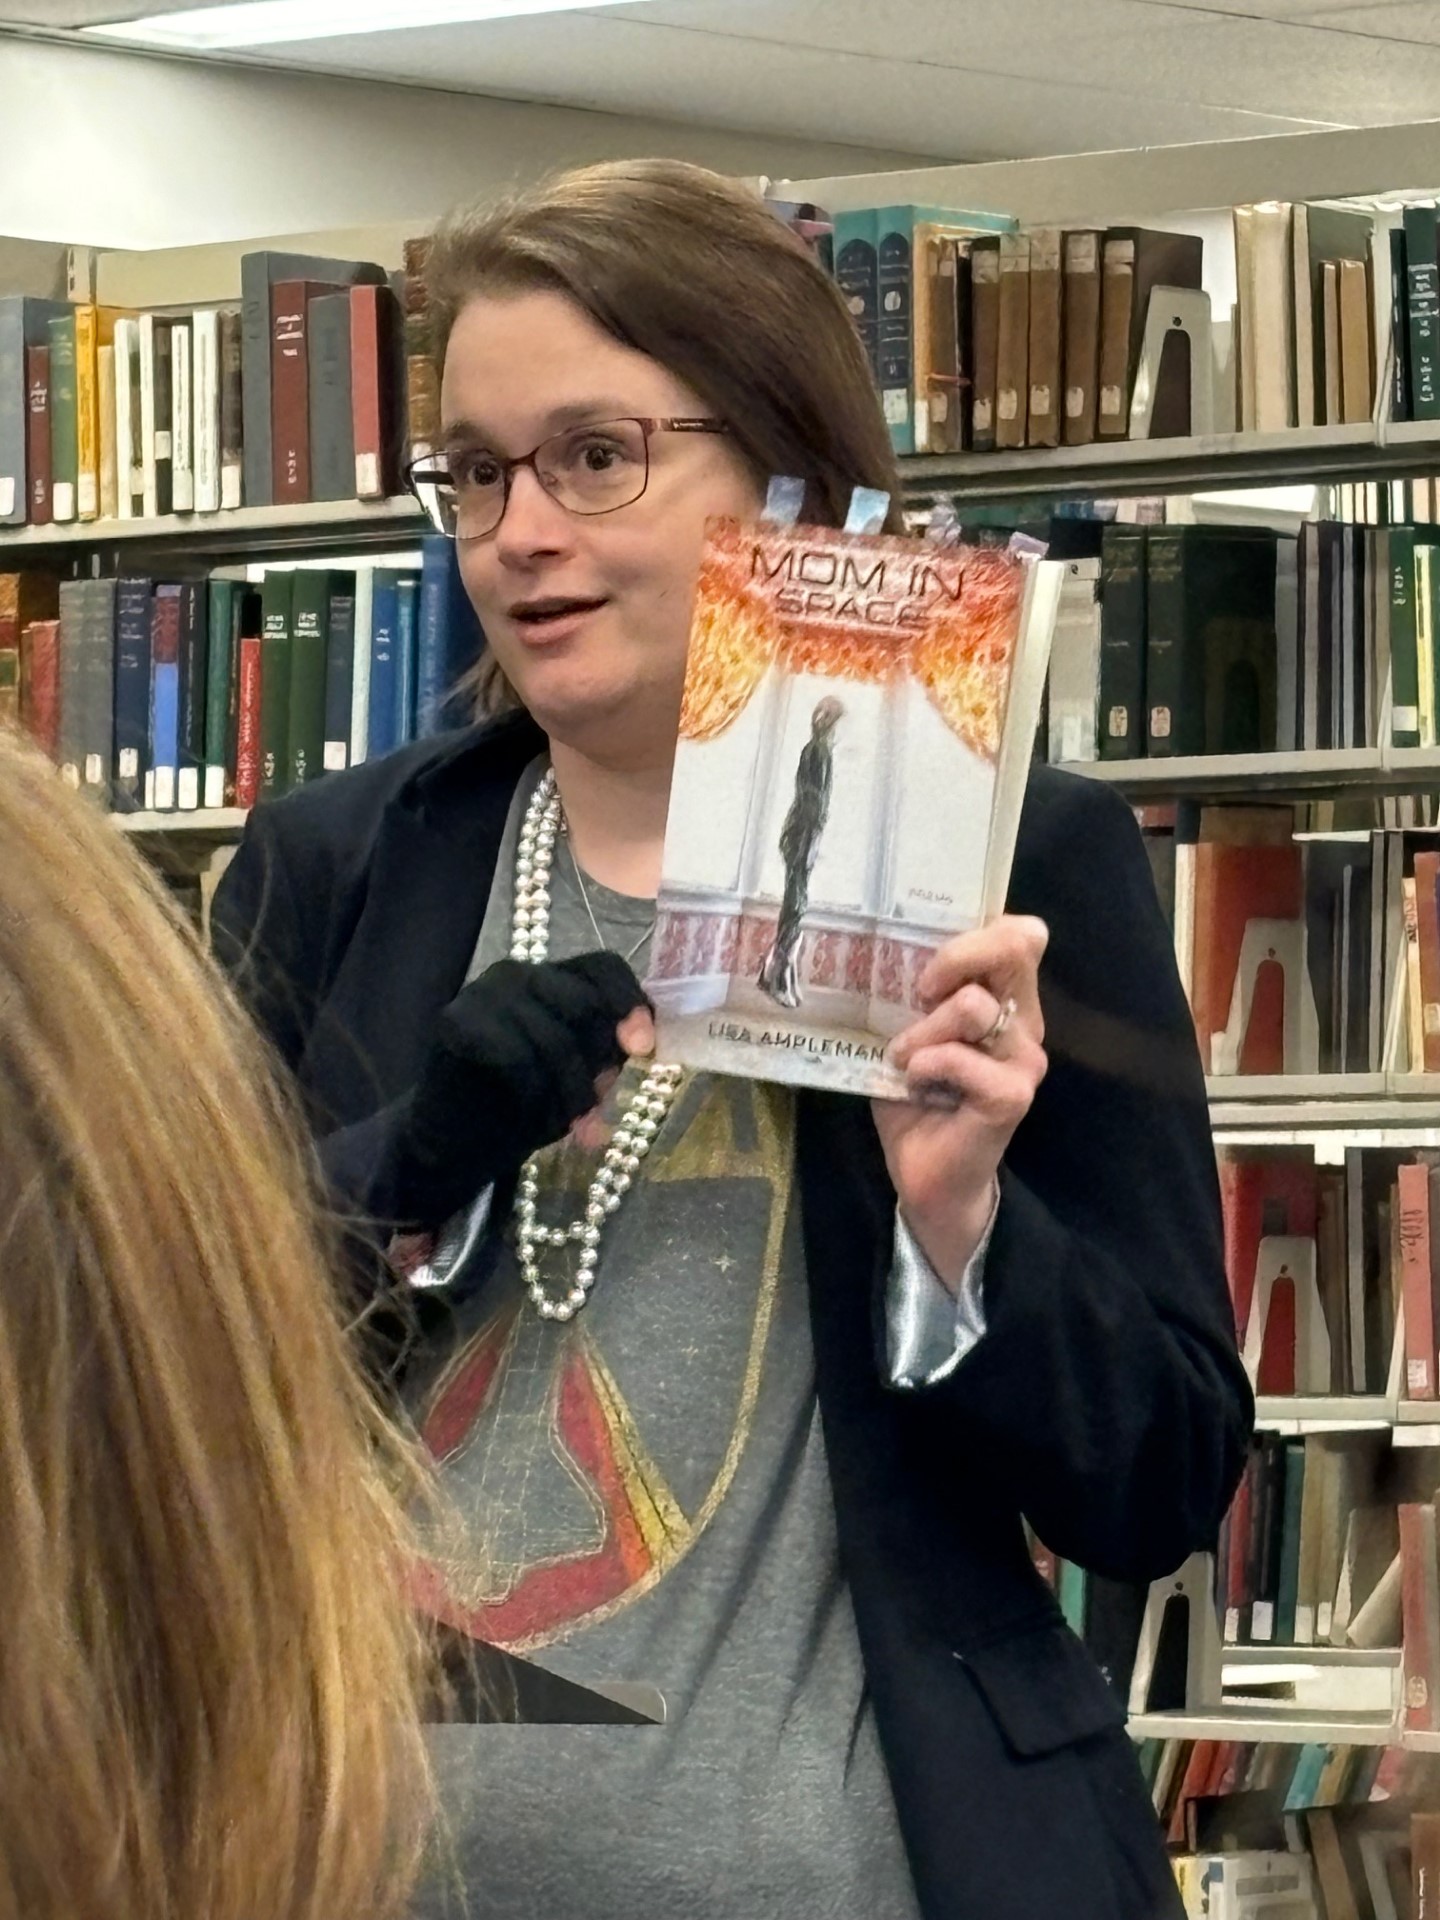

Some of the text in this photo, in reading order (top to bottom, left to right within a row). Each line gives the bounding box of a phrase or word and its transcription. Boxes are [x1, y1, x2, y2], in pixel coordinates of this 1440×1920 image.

[751, 545, 966, 602] MOM IN
[773, 587, 931, 630] SPACE
[708, 1022, 885, 1063] LISA AMPLEMAN
